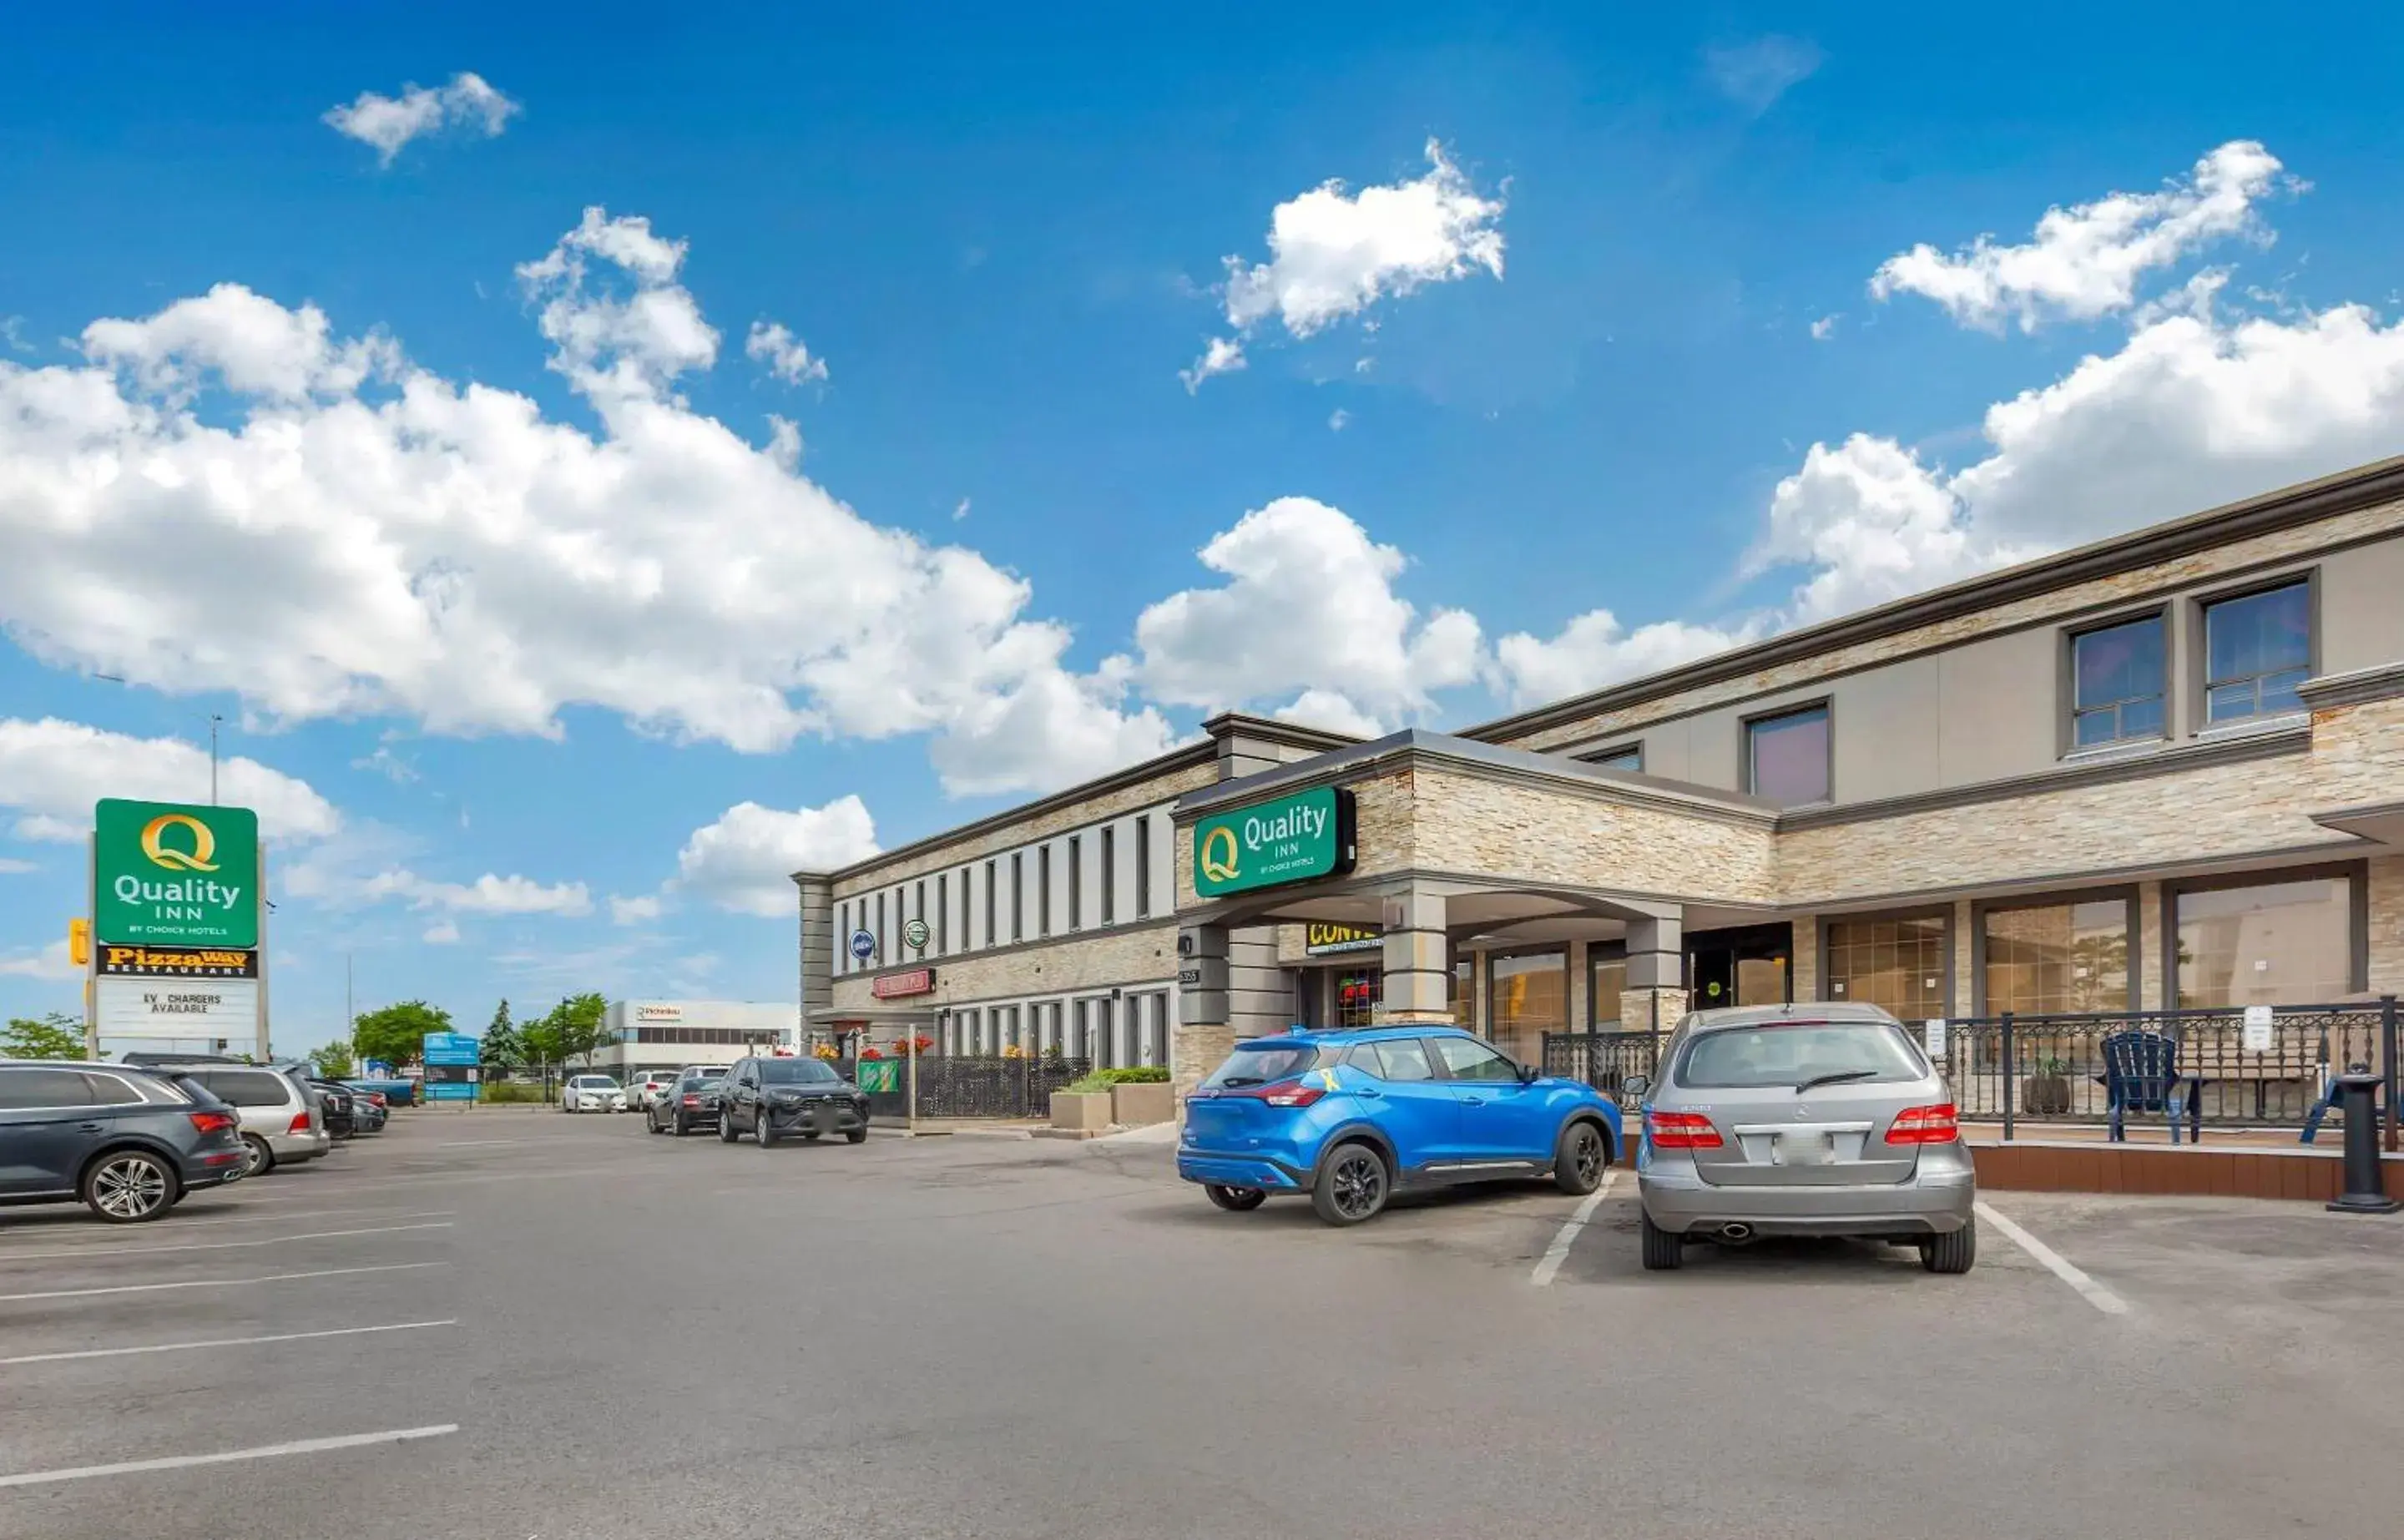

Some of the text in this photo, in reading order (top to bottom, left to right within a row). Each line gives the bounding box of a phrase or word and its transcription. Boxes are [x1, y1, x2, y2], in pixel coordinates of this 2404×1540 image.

[1245, 805, 1327, 851] Quality
[1275, 842, 1299, 859] INN
[114, 875, 240, 909] Quality
[155, 906, 203, 920] INN
[146, 926, 185, 934] CHOICE
[107, 964, 245, 975] RESTAURANT
[144, 994, 221, 1004] EV CHARGERS
[151, 1004, 208, 1013] AVAILABLE
